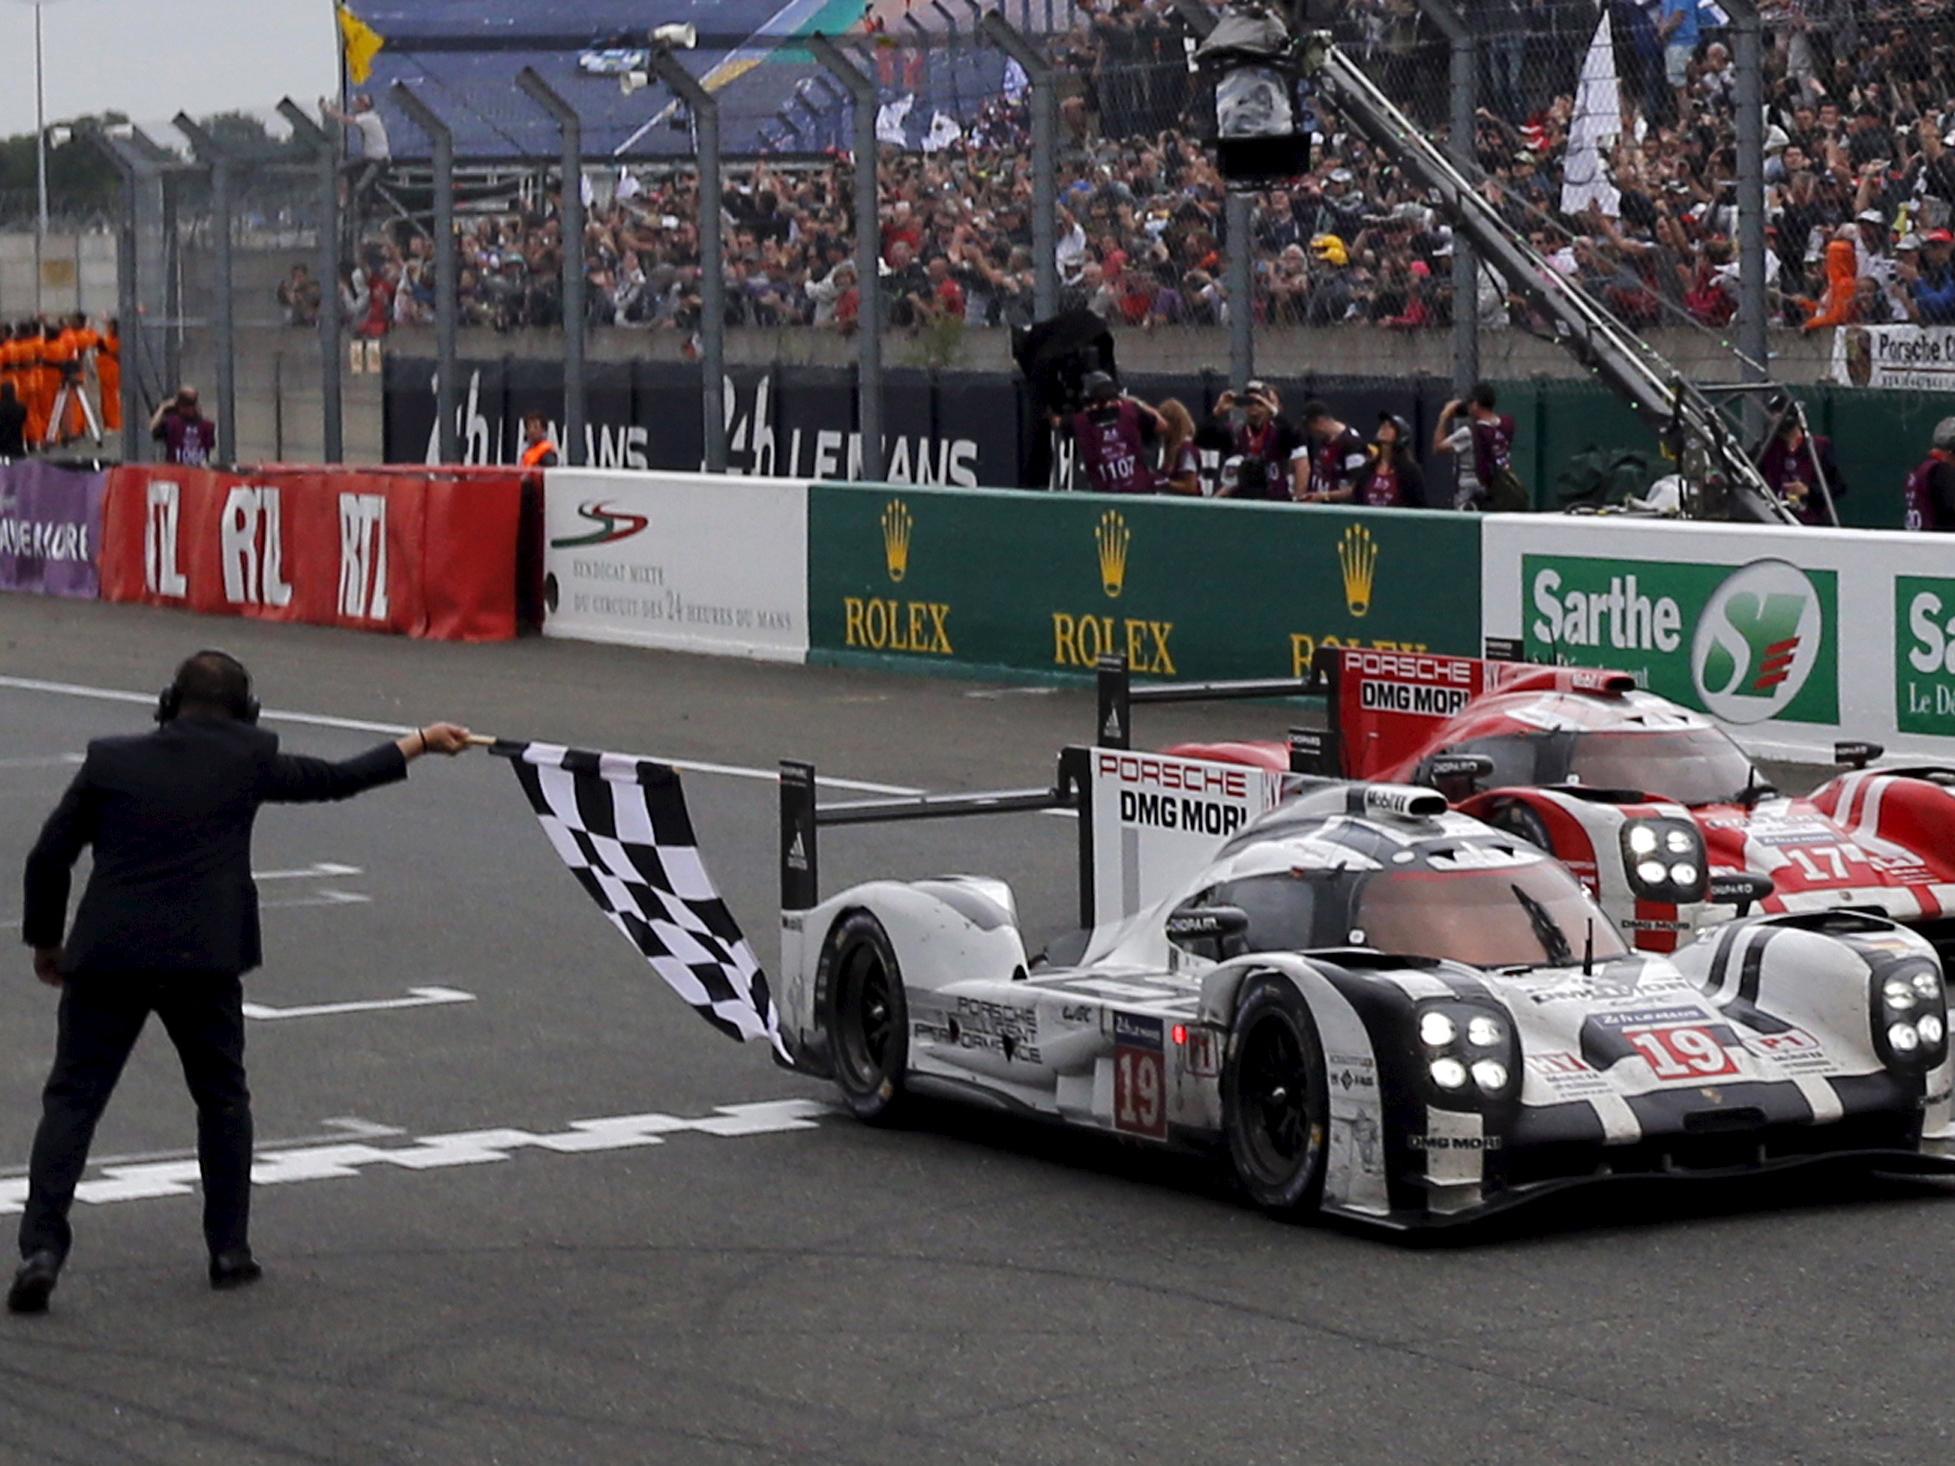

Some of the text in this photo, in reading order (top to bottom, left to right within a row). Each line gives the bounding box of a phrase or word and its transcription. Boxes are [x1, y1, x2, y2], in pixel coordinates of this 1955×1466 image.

[1879, 334, 1940, 360] Porsche
[757, 610, 792, 632] MANS
[844, 597, 953, 653] ROLEX
[1533, 569, 1682, 653] Sarthe
[1053, 614, 1177, 674] ROLEX
[1344, 652, 1471, 683] PORSCHE
[1362, 682, 1411, 710] DMG
[1909, 682, 1931, 714] Le
[1100, 754, 1247, 798] PORSCHE
[1121, 790, 1177, 829] DMG
[1786, 846, 1850, 881] 17
[957, 996, 1038, 1028] PORSCHE
[1632, 1029, 1726, 1076] 19
[1120, 1053, 1158, 1127] 19
